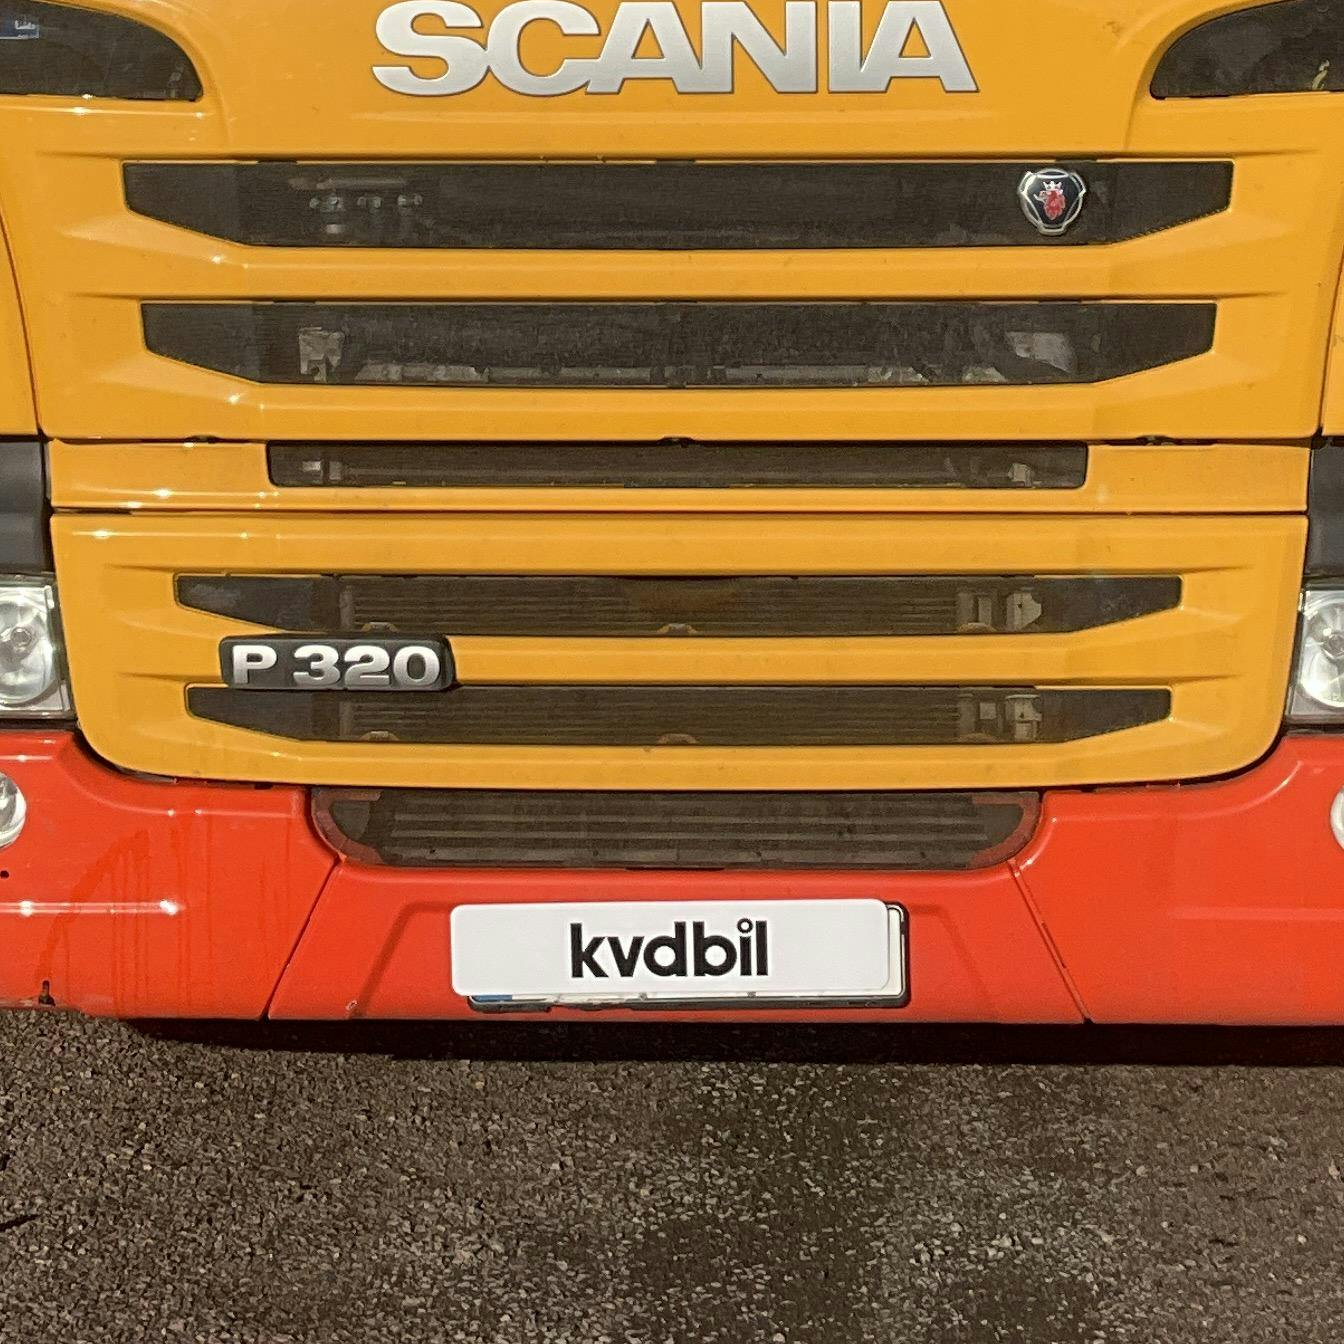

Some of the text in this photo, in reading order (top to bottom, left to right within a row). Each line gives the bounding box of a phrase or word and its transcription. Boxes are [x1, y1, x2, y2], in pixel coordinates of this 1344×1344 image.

[233, 645, 440, 686] P 320
[570, 917, 769, 978] kvdbil
